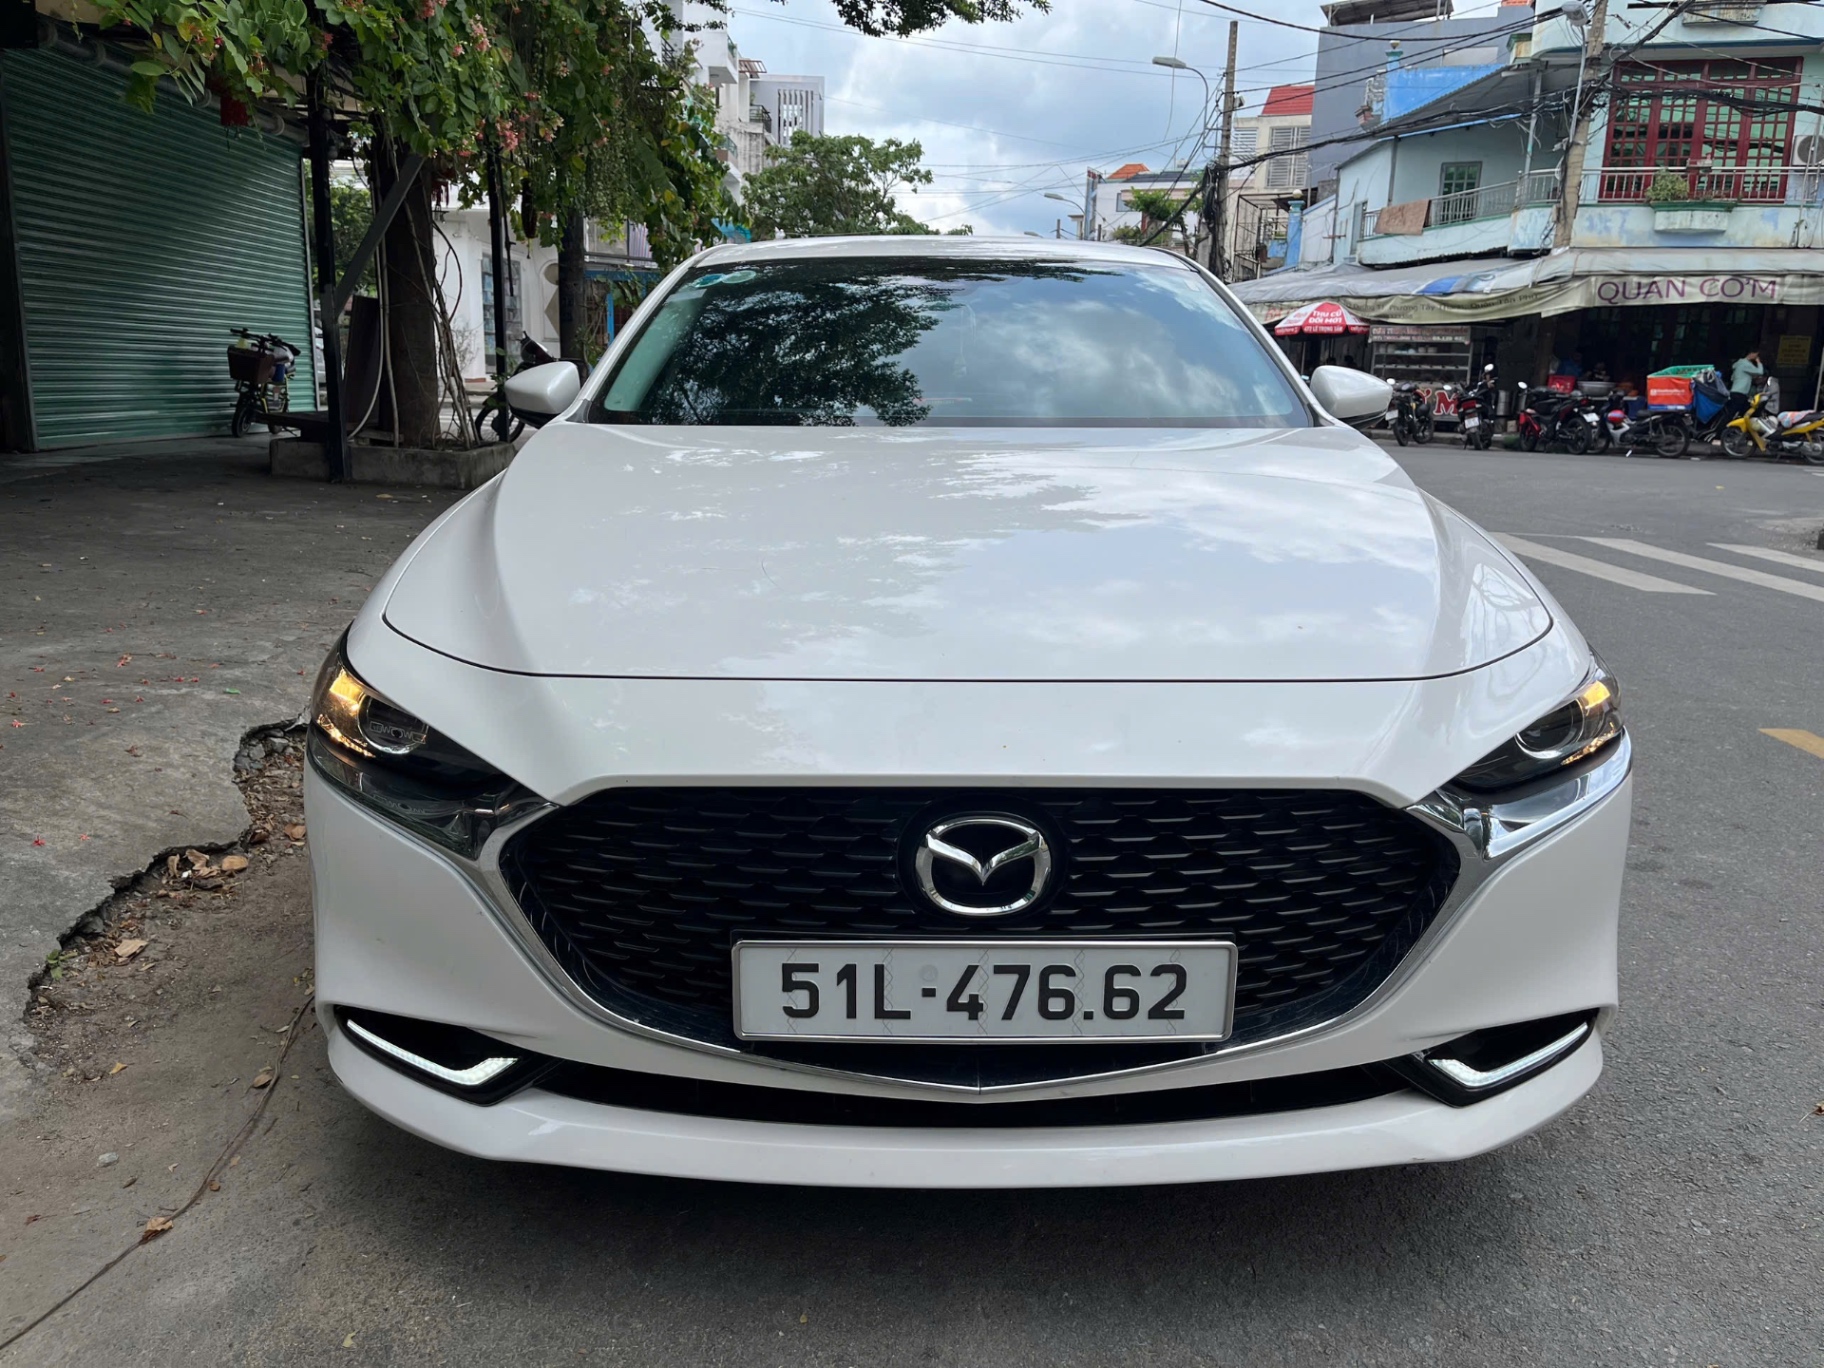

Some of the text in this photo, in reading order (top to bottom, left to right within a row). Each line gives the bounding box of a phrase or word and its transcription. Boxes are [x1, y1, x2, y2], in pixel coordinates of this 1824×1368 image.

[1699, 277, 1777, 299] CƠM
[1312, 310, 1329, 318] THU
[781, 962, 1188, 1022] 51L-476.62
